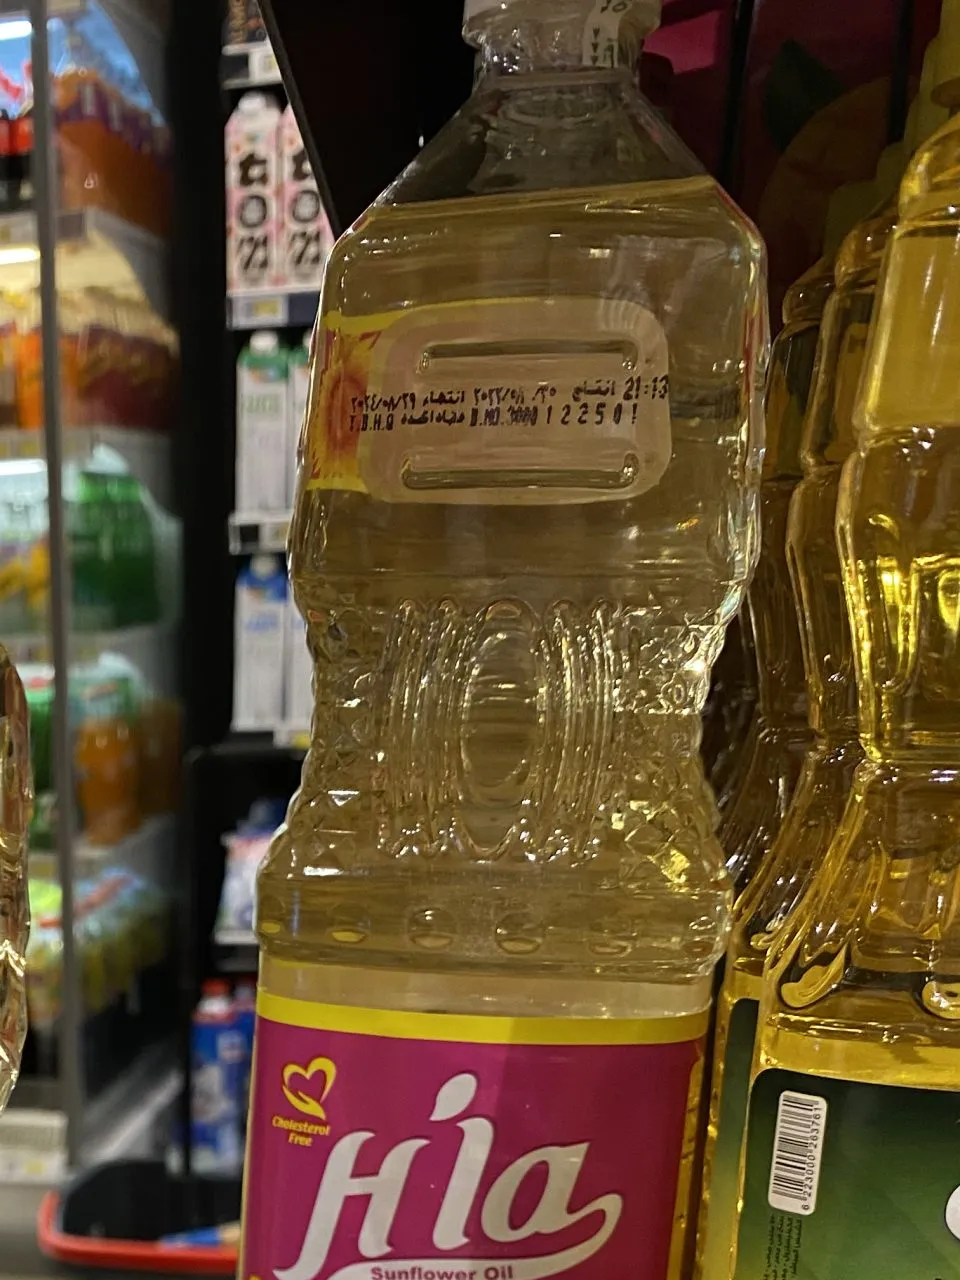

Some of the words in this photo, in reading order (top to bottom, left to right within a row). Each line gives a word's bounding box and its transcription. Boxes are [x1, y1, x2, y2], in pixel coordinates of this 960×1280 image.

[272, 1115, 331, 1136] Cholesterol
[288, 1132, 313, 1146] Free
[484, 1265, 513, 1280] Oil
